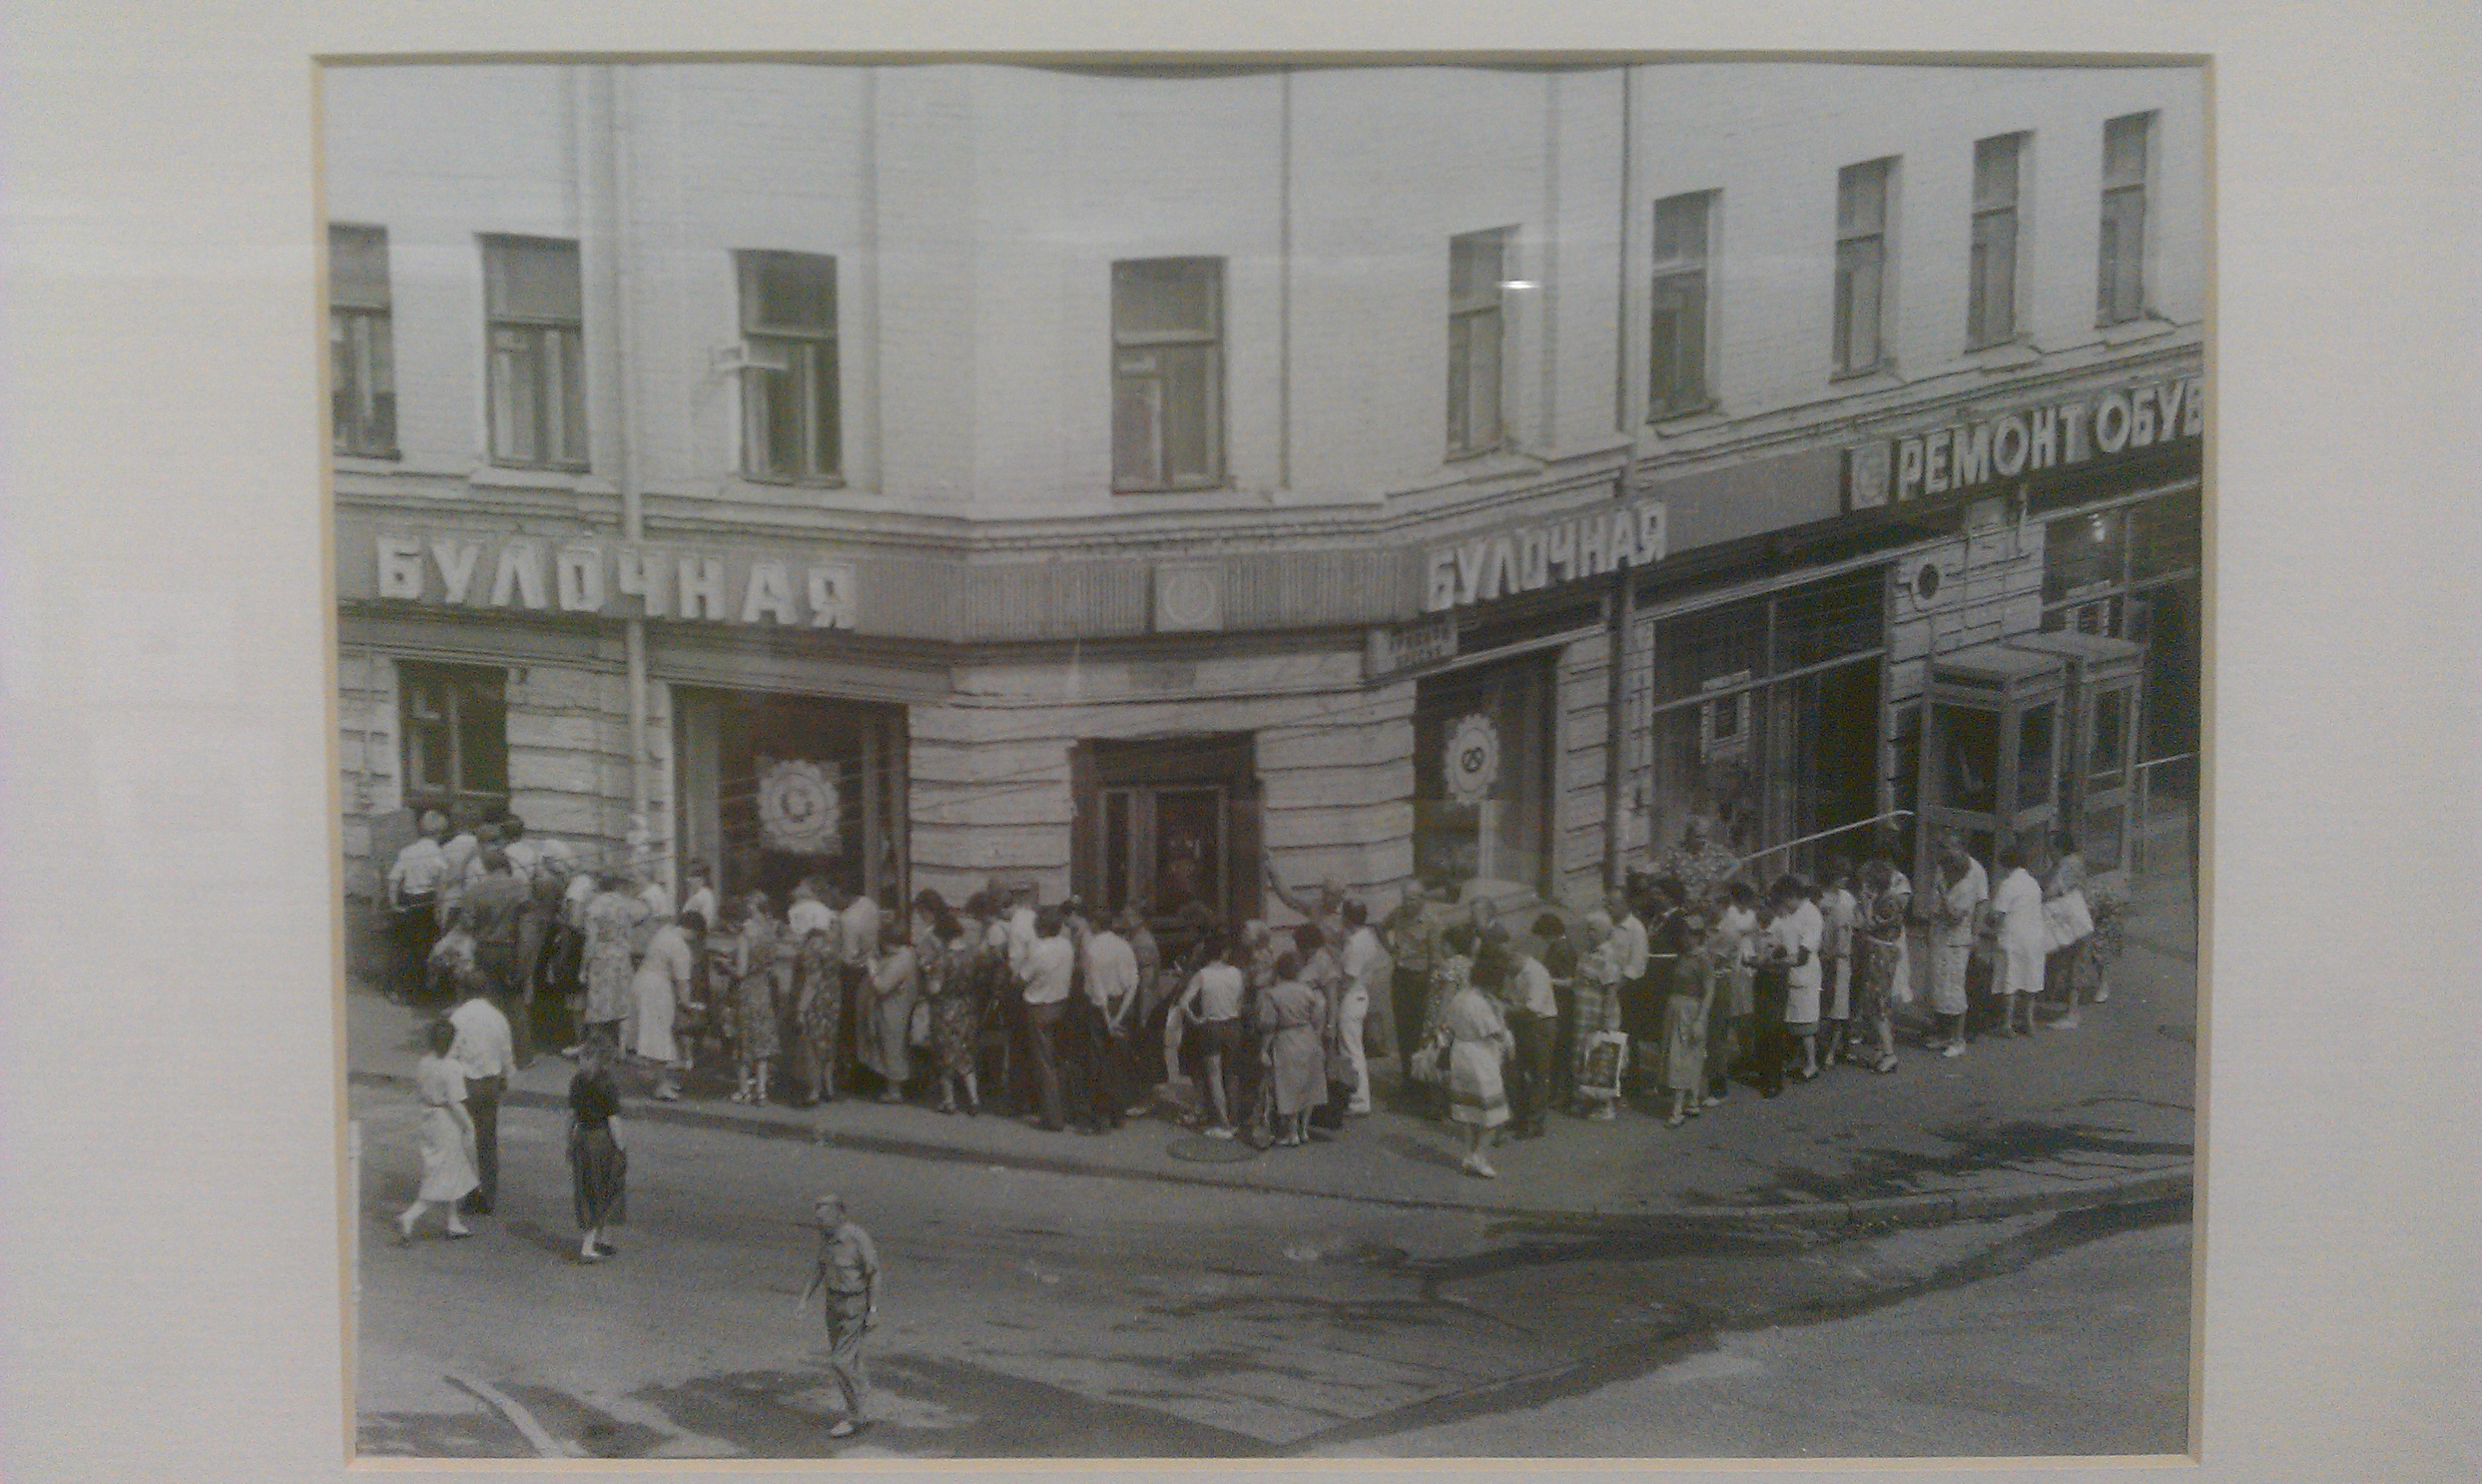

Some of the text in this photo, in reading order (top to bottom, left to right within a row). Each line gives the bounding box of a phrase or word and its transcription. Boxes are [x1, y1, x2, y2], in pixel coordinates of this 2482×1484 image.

[1898, 404, 2091, 501] РЕМОНТ
[376, 534, 857, 630] БУЛОЧНАЯ
[1427, 500, 1668, 613] БУЛОЧНАЯ
